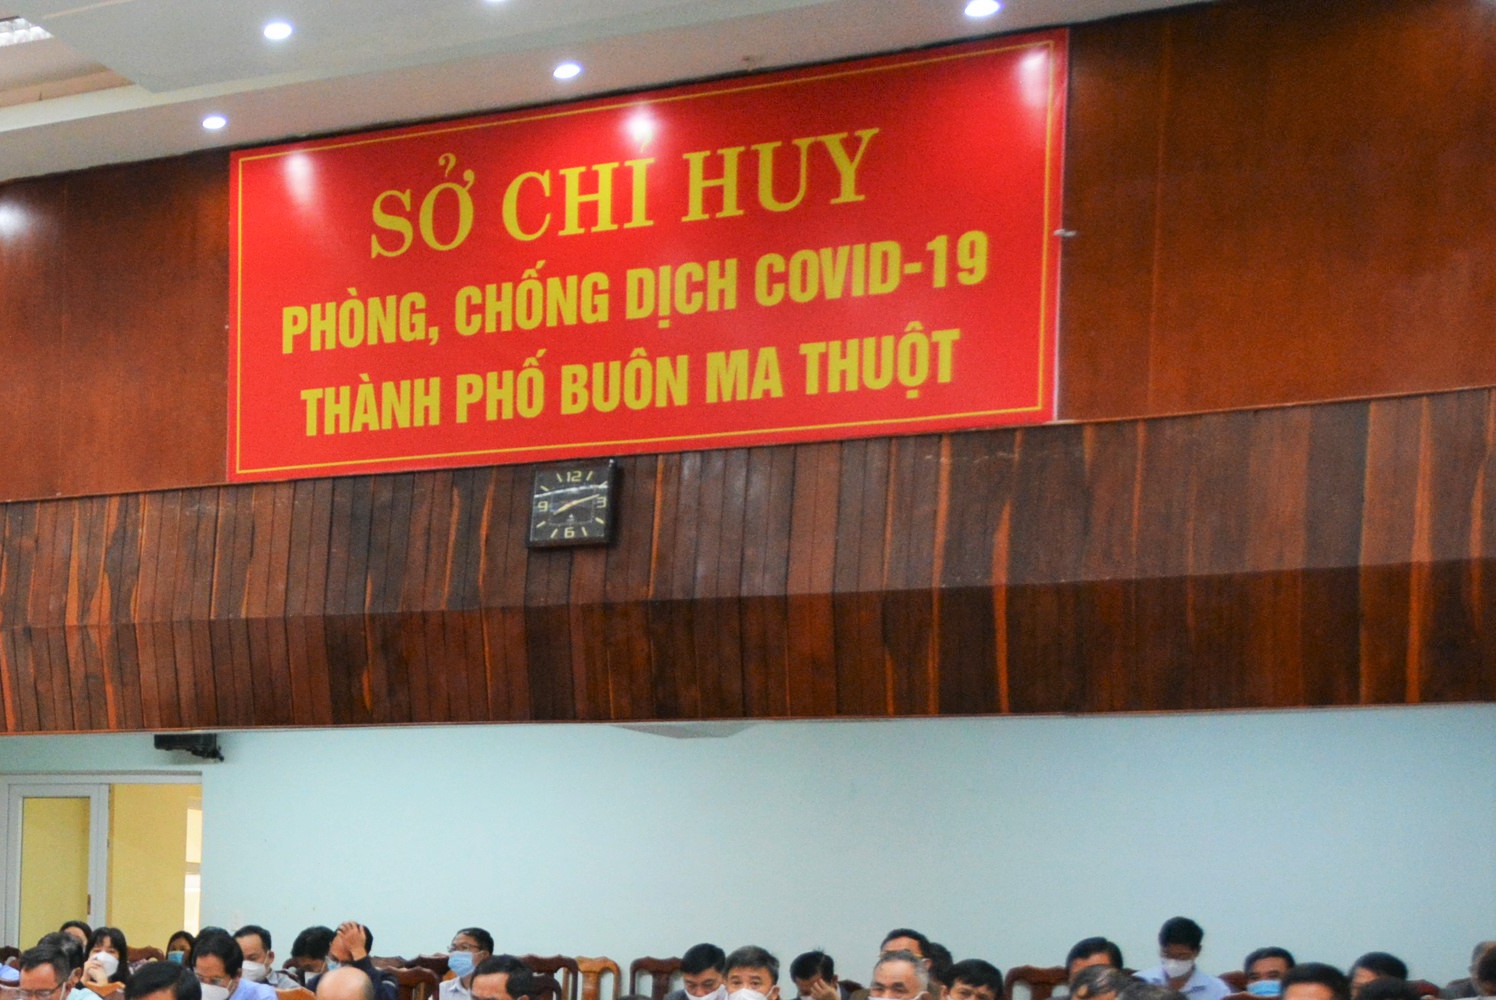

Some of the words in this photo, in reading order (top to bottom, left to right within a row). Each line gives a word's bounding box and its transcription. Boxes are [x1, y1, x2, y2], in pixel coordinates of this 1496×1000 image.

[370, 152, 475, 259] SỞ
[681, 128, 880, 223] HUY
[282, 289, 439, 354] PHÒNG,
[454, 260, 609, 338] CHỐNG
[626, 258, 737, 328] DỊCH
[754, 230, 989, 305] COVID-19
[300, 373, 440, 437] THÀNH
[456, 347, 544, 424] PHỐ
[561, 347, 687, 414] BUÔN
[706, 346, 782, 403] MA
[799, 321, 960, 398] THUỘT
[538, 501, 548, 512] 9
[566, 470, 582, 482] 12
[564, 527, 575, 538] 6
